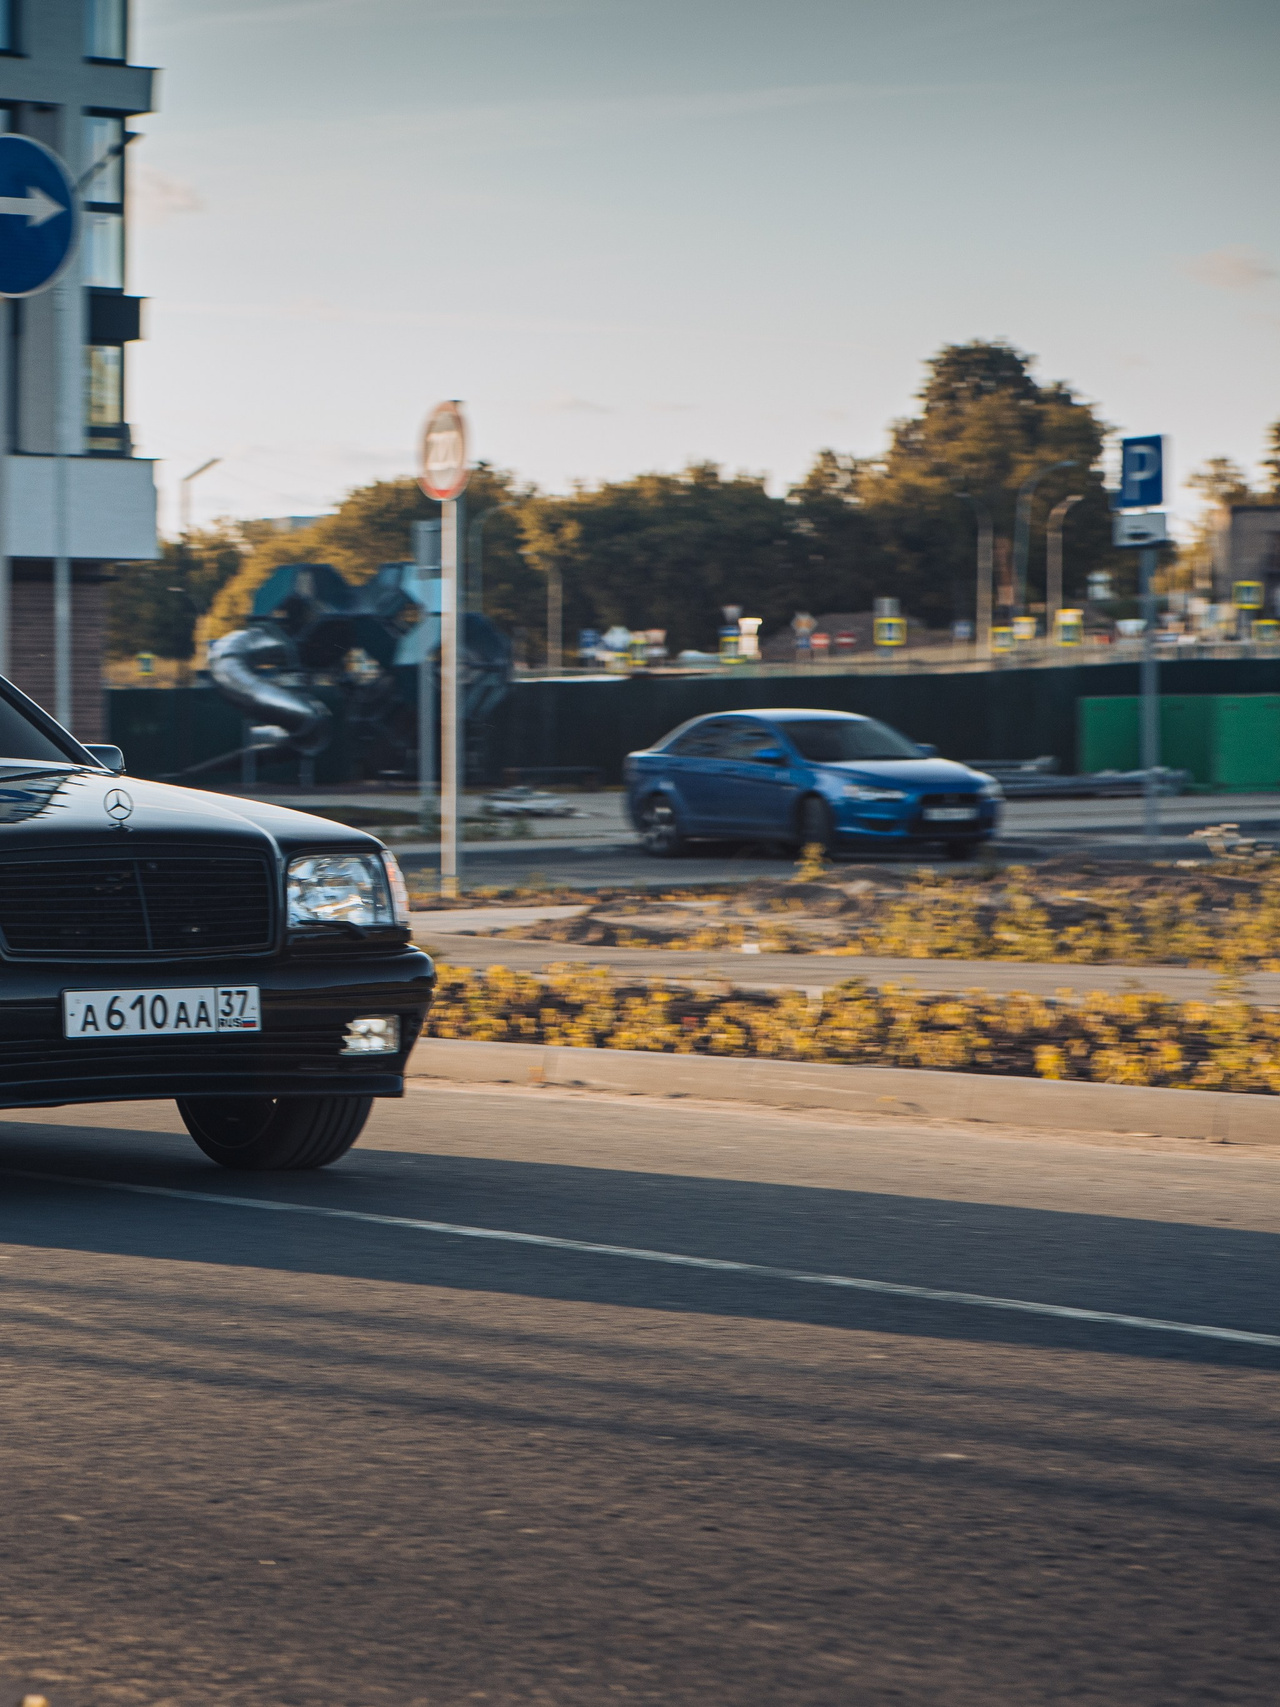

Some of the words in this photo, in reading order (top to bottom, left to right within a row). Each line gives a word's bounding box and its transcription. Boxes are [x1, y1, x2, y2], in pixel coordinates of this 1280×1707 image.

[1122, 444, 1160, 500] P
[80, 994, 213, 1032] A610AA
[220, 990, 248, 1017] 37
